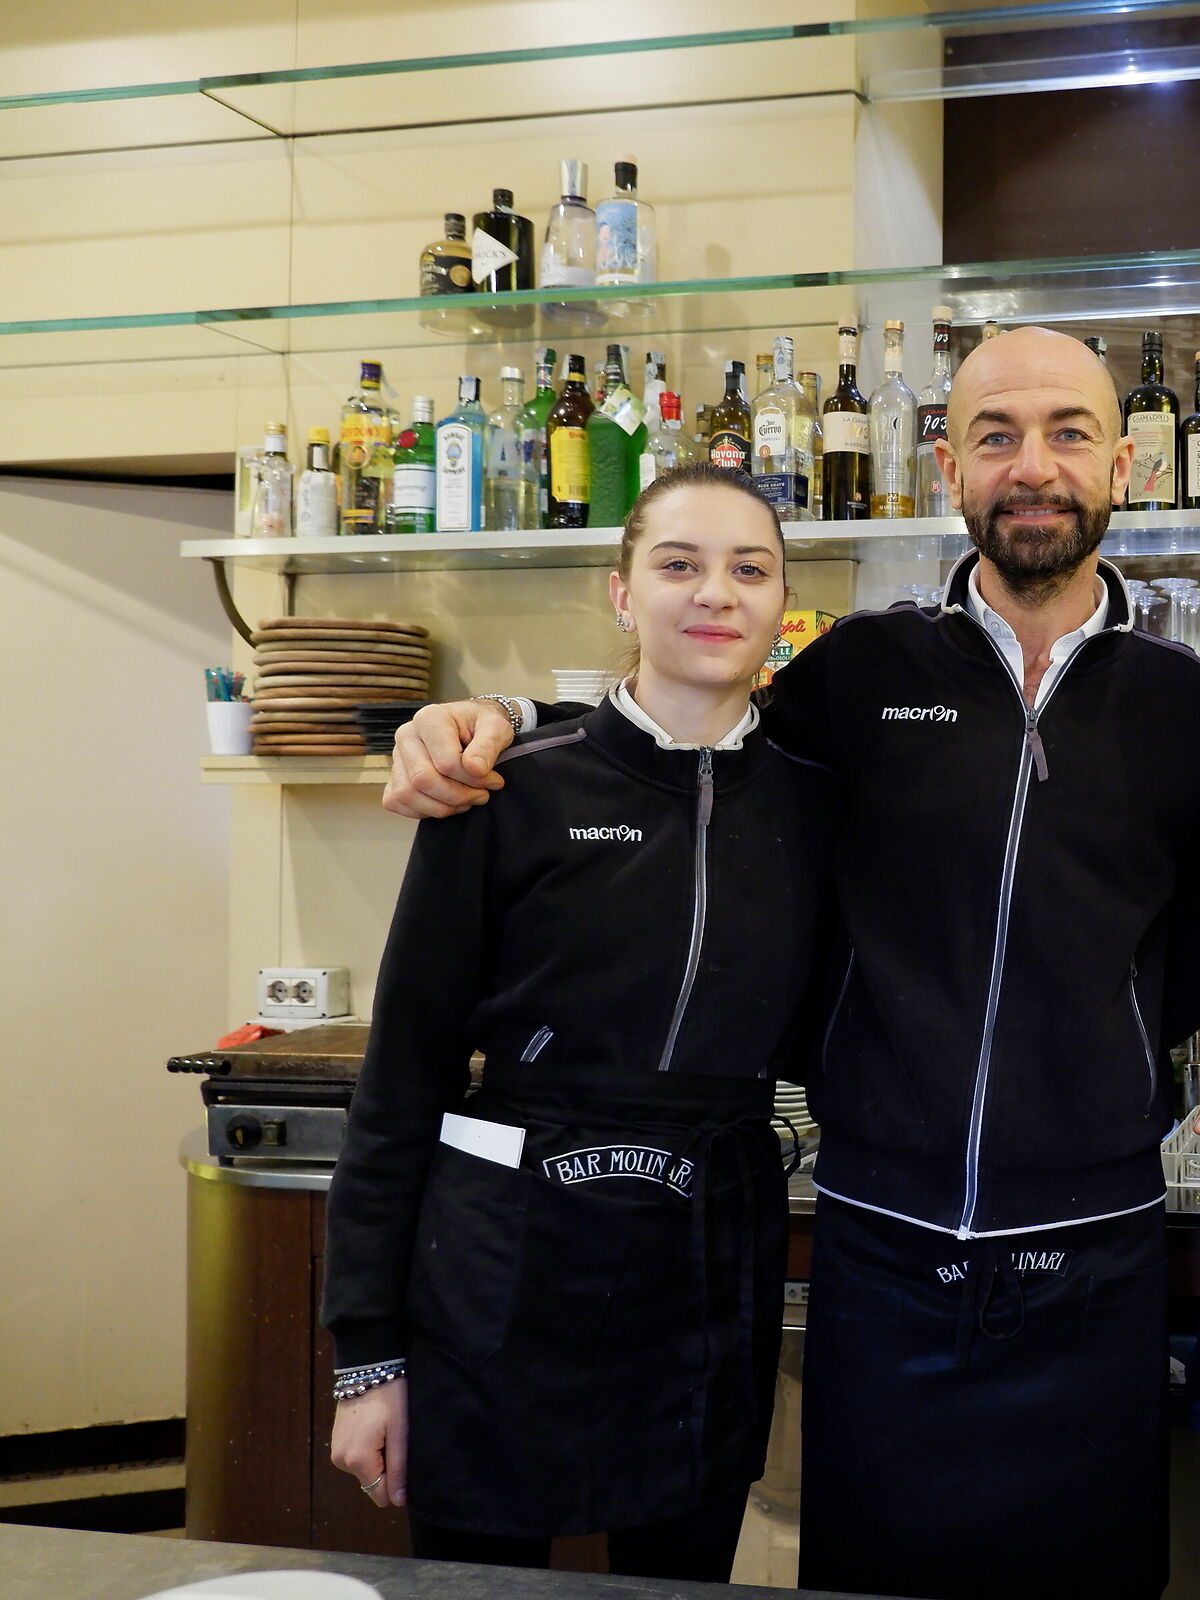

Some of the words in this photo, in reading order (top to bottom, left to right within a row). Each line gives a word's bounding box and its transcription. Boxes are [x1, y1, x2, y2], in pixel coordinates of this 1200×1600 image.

[710, 449, 746, 460] Havana
[716, 459, 737, 468] Club
[882, 705, 958, 722] macron
[569, 825, 642, 841] macron
[556, 1153, 602, 1182] BAR
